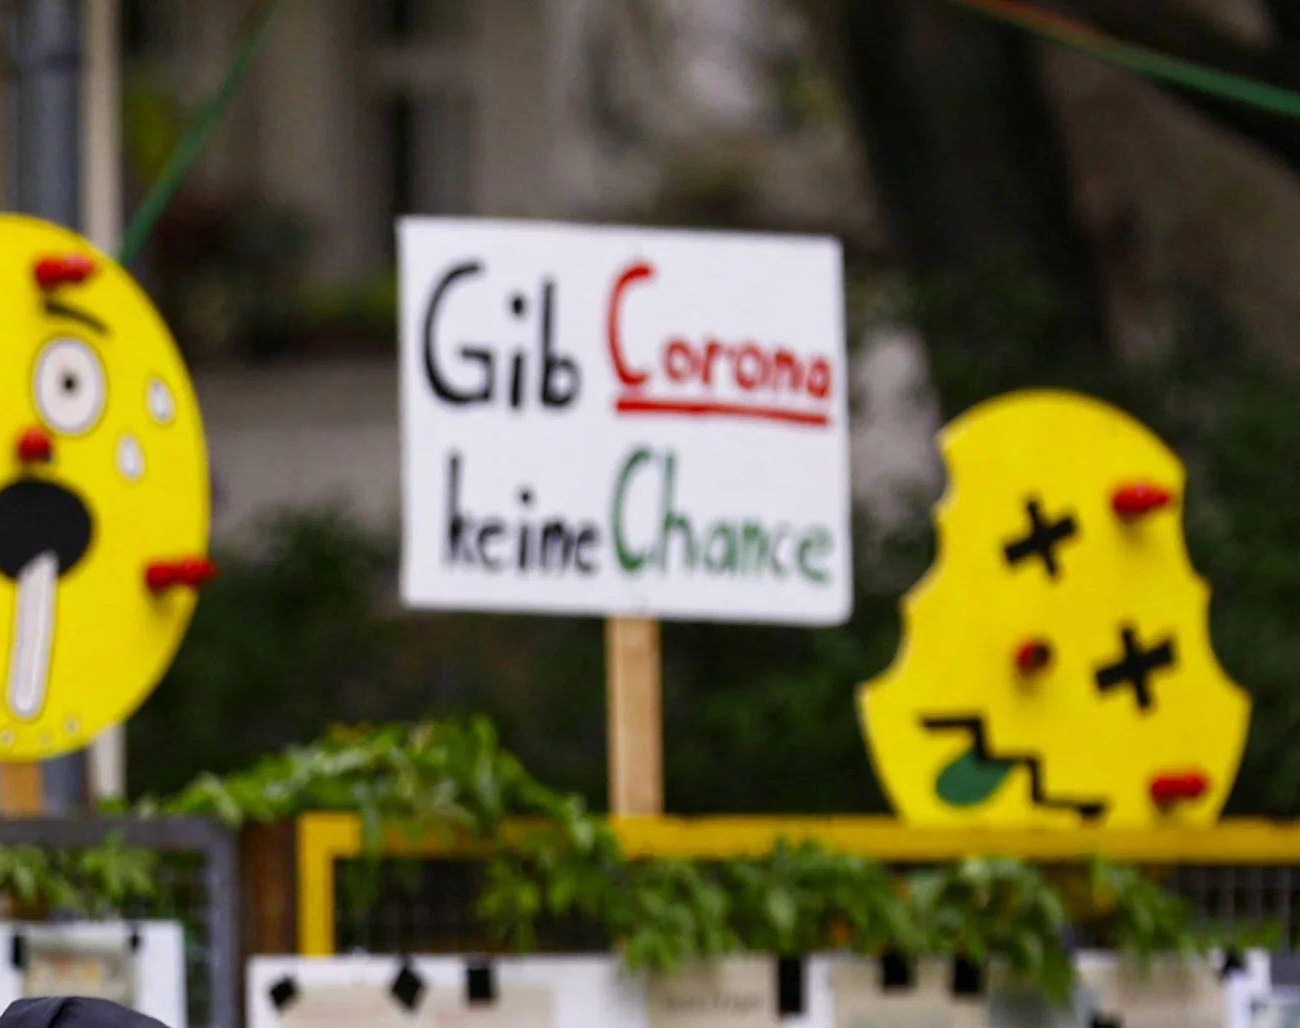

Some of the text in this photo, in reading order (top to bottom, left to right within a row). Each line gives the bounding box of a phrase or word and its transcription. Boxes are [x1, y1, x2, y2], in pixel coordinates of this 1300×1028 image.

[422, 260, 831, 410] Gib Corona
[445, 447, 831, 584] keine Chance
